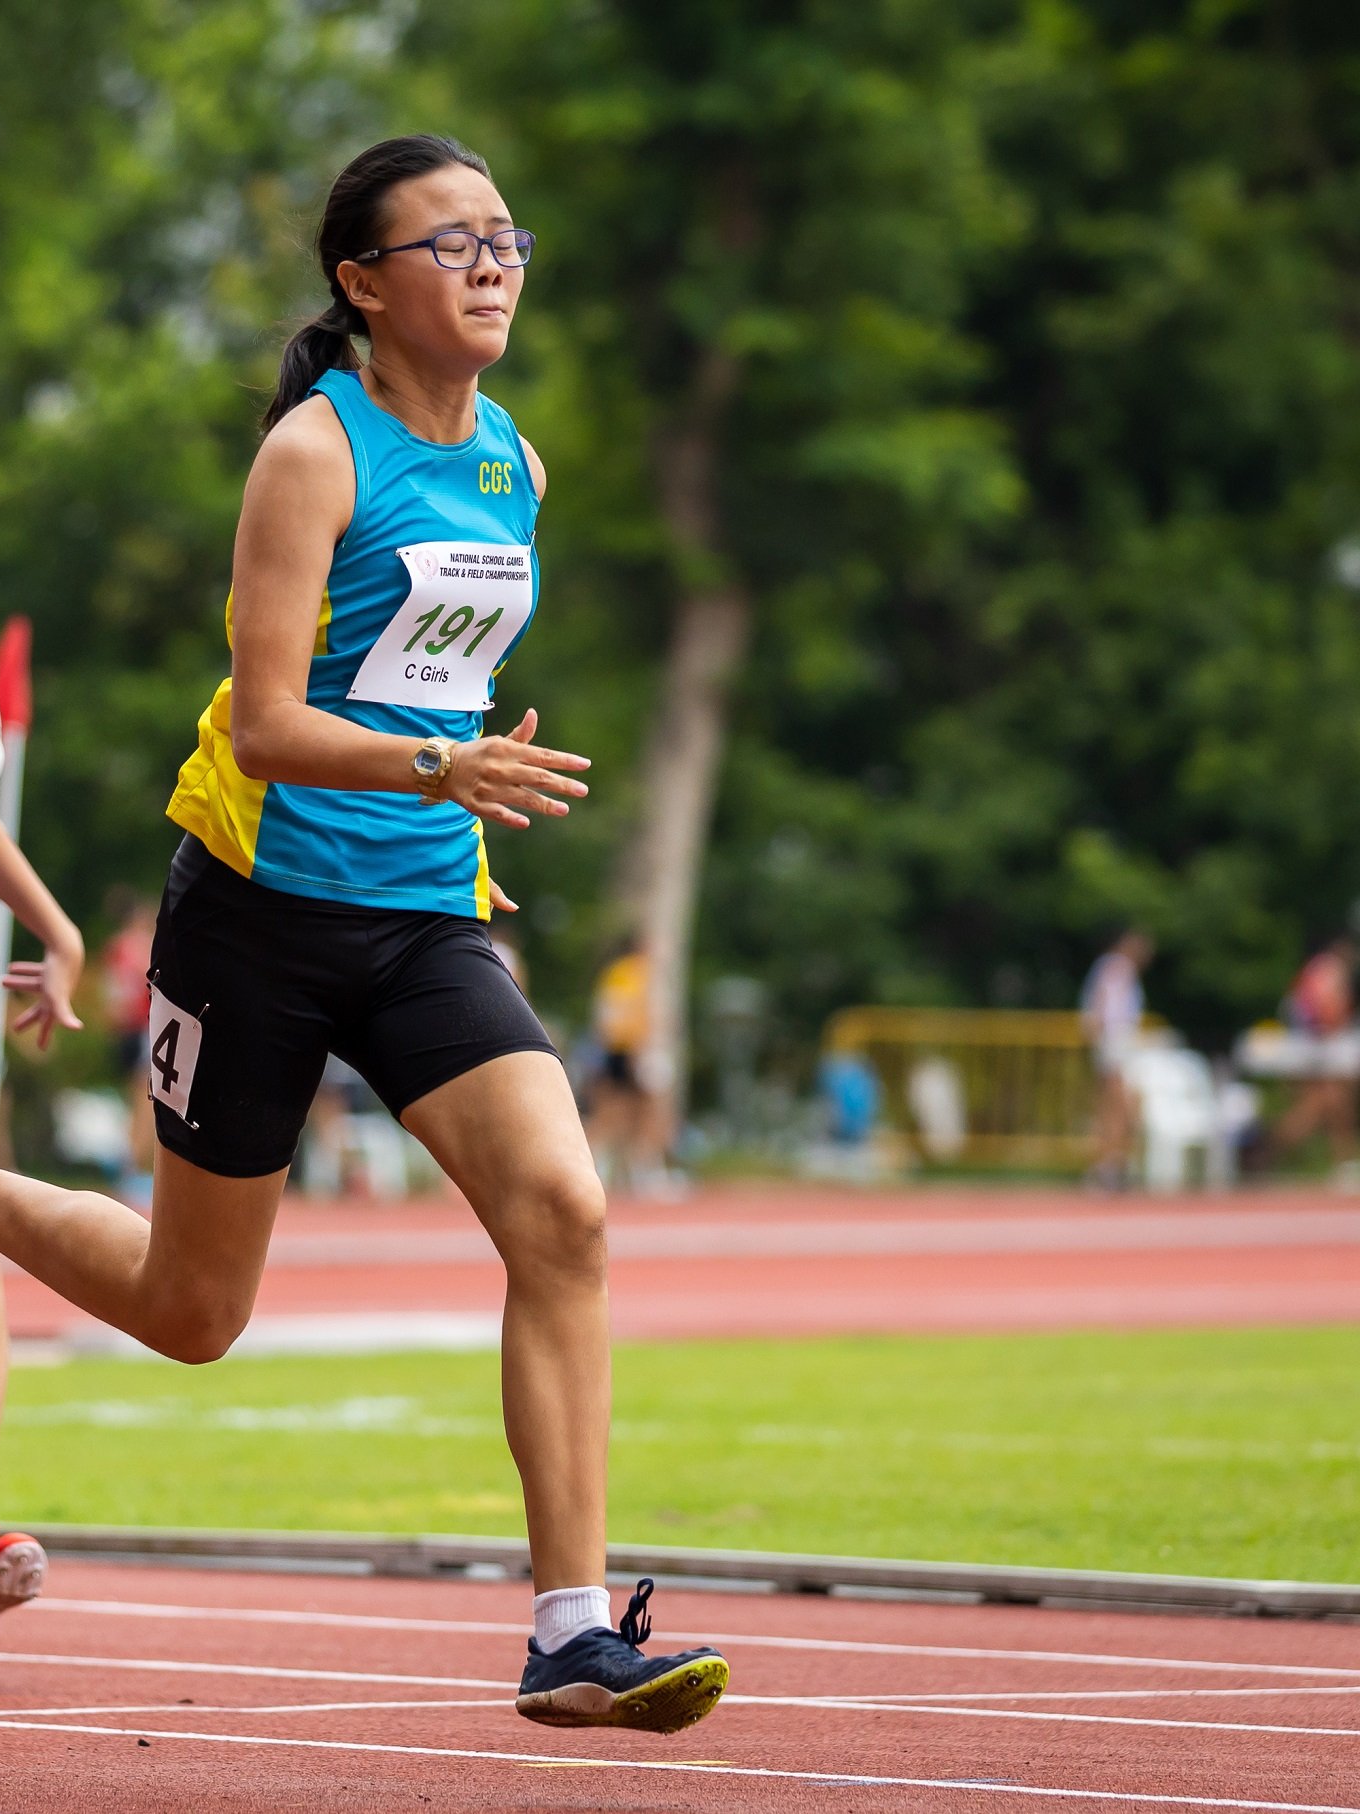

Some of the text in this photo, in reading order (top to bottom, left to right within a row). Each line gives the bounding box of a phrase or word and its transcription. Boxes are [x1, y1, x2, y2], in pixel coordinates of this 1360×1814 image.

[478, 461, 513, 494] CGS
[450, 553, 524, 566] NATIONAL SCHOOL GAMES
[439, 567, 529, 581] TRACK & FIELD CHAMPIONSHIPS
[402, 603, 505, 658] 191
[404, 663, 450, 683] C Girls
[151, 1017, 182, 1095] 4
